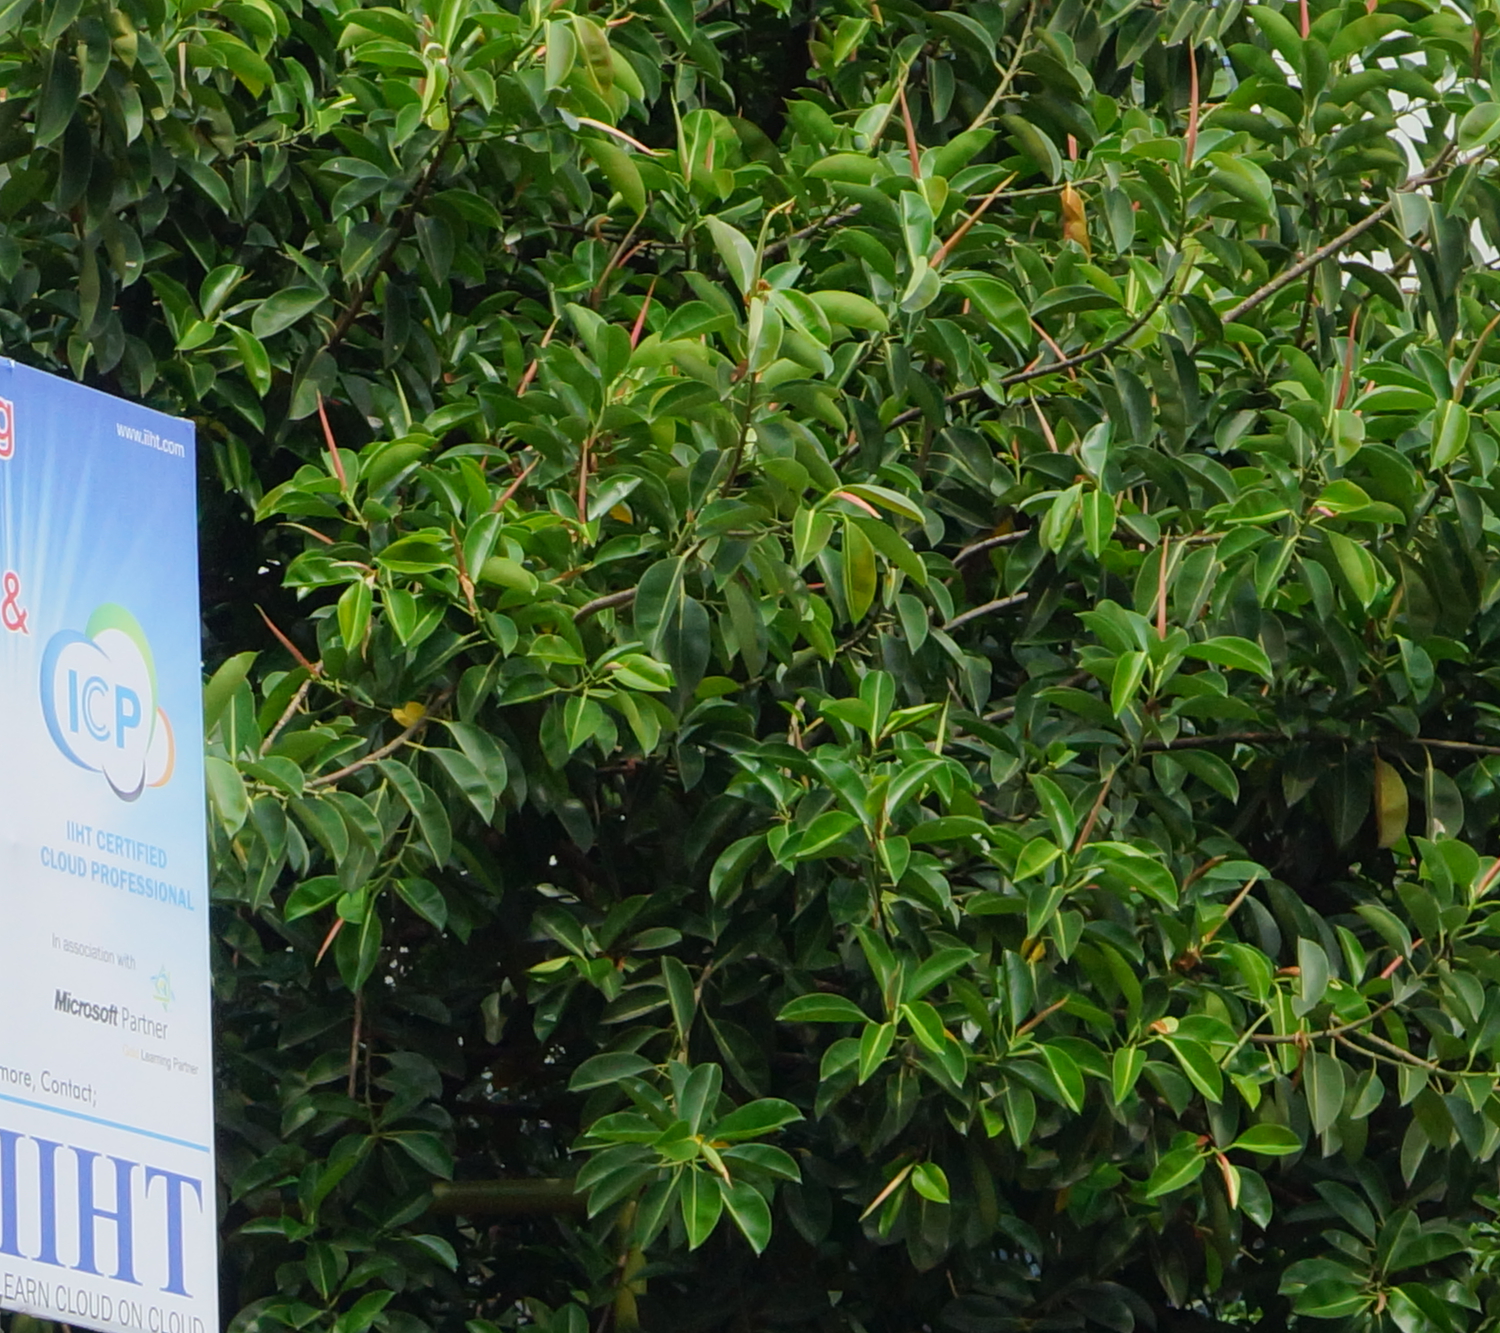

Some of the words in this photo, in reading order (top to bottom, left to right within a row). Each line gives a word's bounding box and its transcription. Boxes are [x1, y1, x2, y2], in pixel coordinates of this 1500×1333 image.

[116, 422, 185, 458] www.iiht.com
[1, 571, 29, 635] &
[68, 668, 142, 749] ICP
[66, 820, 92, 847] IIHT
[96, 829, 168, 870] CERTIFIED
[40, 846, 87, 878] CLOUD
[91, 860, 195, 911] PROFESSIONAL
[52, 932, 61, 949] In
[63, 938, 115, 965] association
[117, 951, 136, 970] with
[54, 989, 118, 1027] Microsoft
[121, 1006, 168, 1040] Partner
[55, 1285, 113, 1322] CLOUD
[118, 1299, 143, 1330] ON
